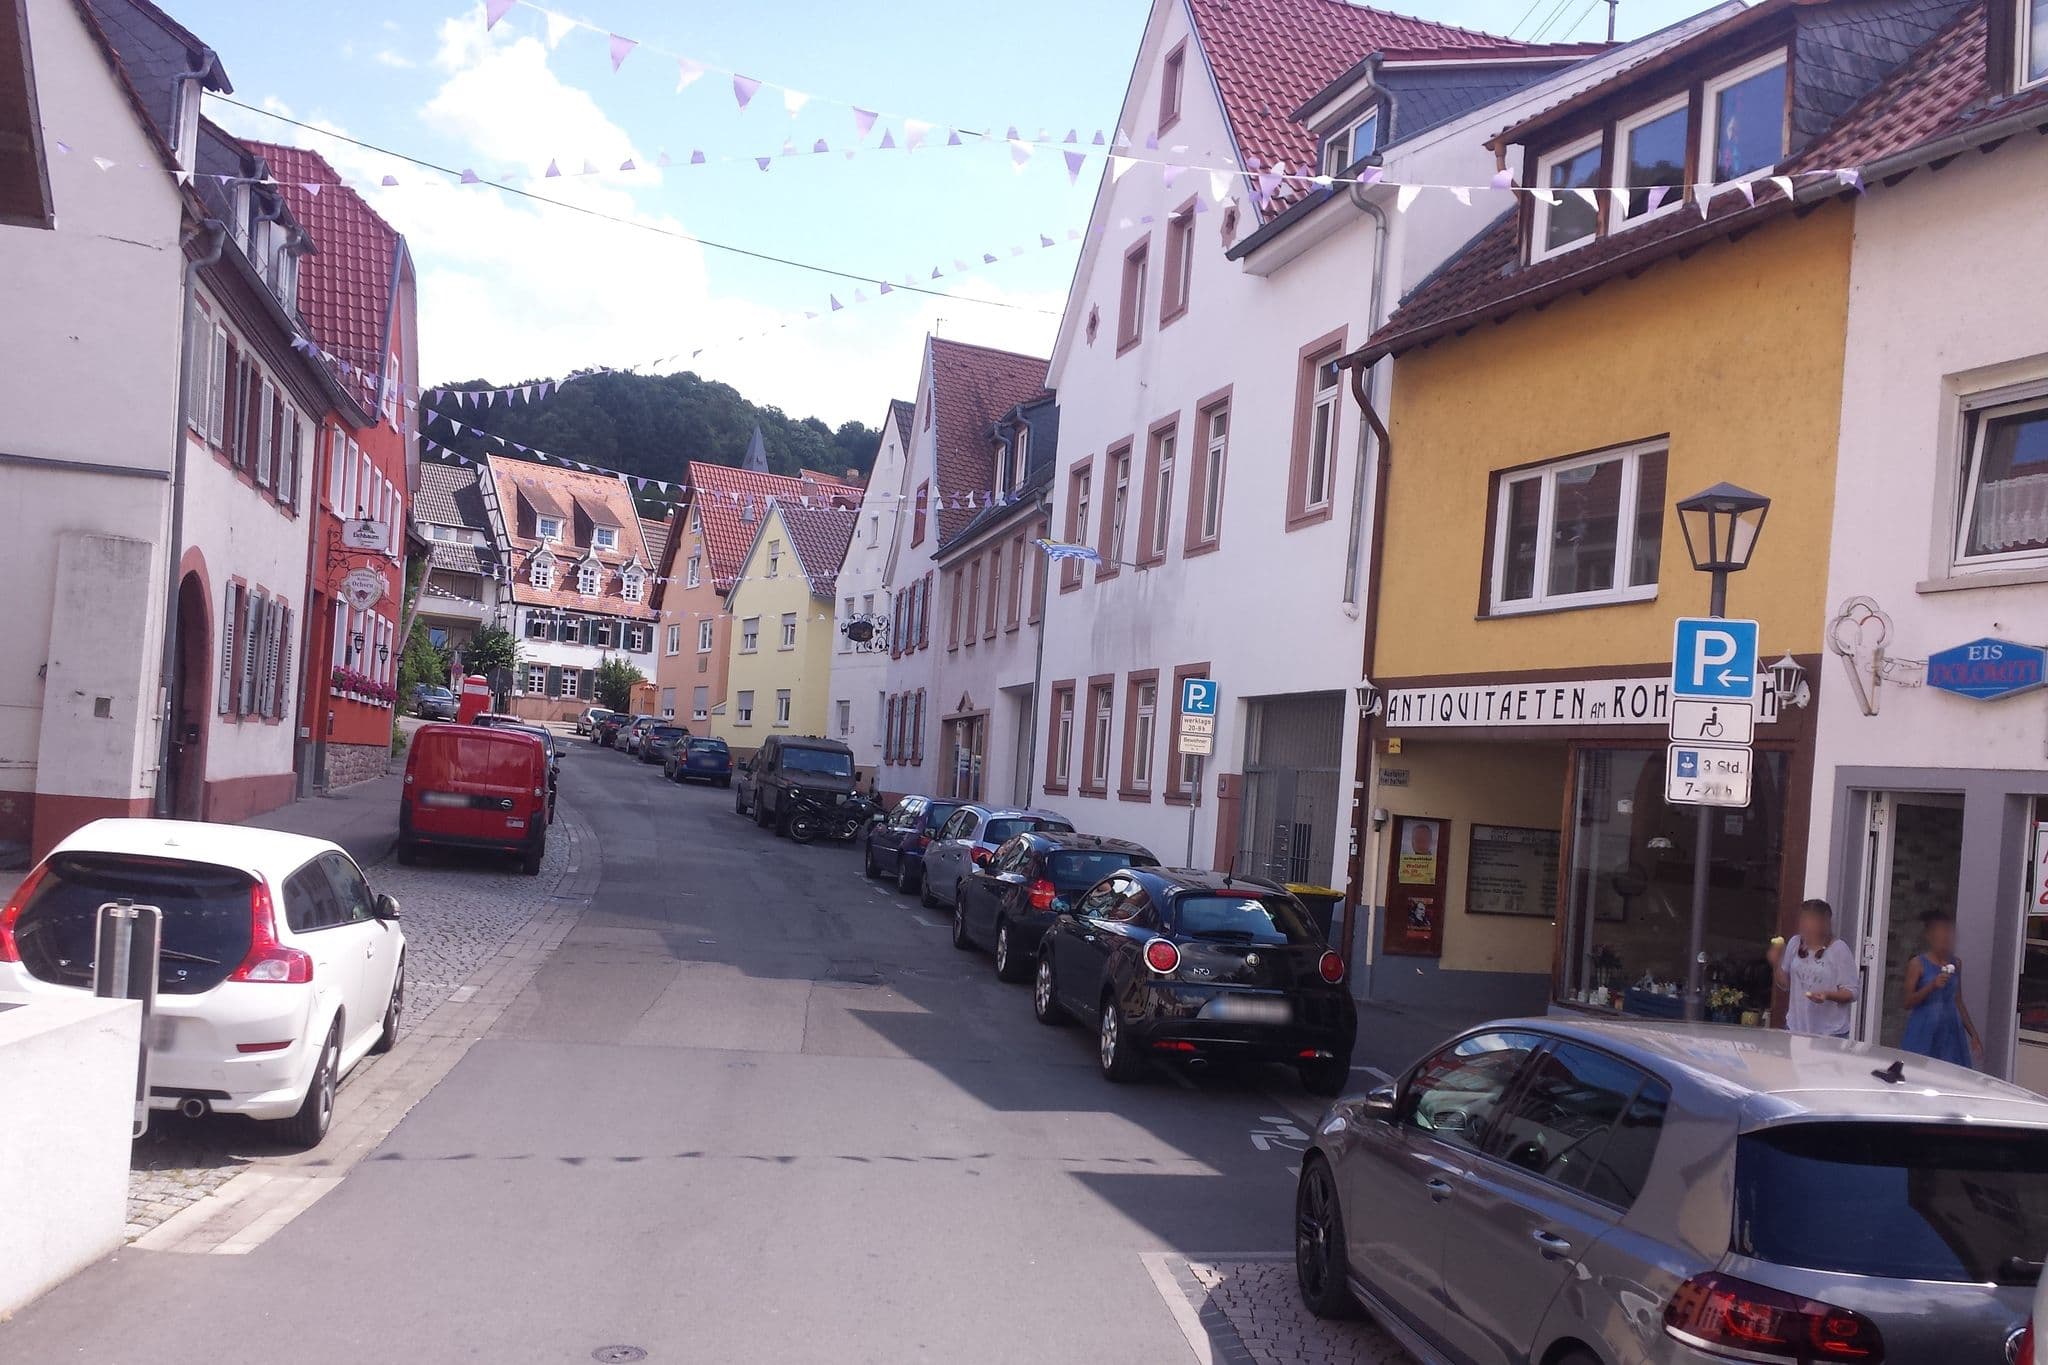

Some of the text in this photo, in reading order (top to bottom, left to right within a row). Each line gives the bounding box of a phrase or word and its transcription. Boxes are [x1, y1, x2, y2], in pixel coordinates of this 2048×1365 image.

[1693, 630, 1737, 686] P
[1968, 645, 2003, 660] EIS
[1188, 684, 1207, 709] P
[1388, 687, 1585, 721] ANTIQUITAETEN
[1590, 702, 1606, 718] AM
[1704, 760, 1743, 774] 3 Std.
